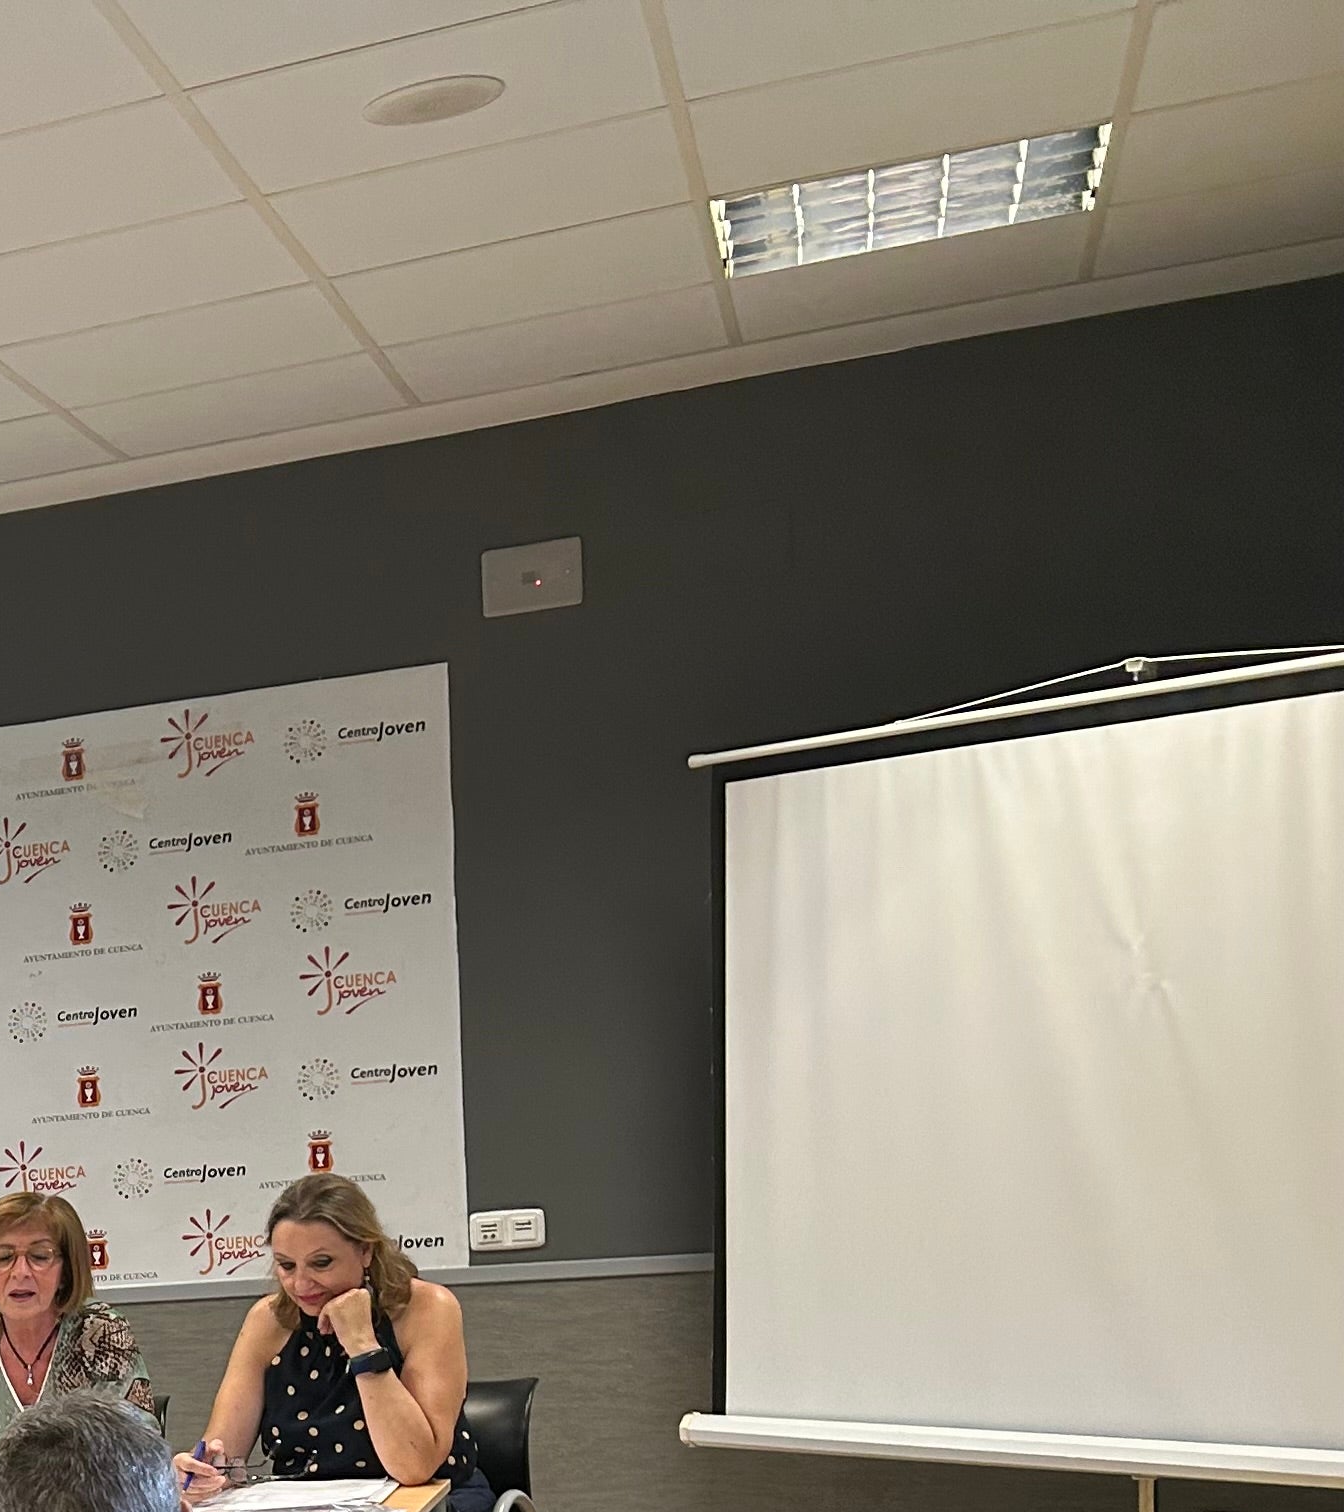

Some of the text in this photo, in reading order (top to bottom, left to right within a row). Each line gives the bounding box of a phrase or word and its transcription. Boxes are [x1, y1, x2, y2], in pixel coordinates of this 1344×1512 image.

[338, 720, 426, 741] CentroJoven
[193, 731, 255, 751] CUENCA
[197, 747, 244, 768] joven
[15, 785, 84, 801] AYUNTAMIENTO
[12, 840, 70, 858] CUENCA
[149, 832, 232, 852] CentroJoven
[244, 839, 318, 856] AYUNTAMIENTO
[336, 833, 374, 847] CUENCA
[16, 856, 61, 874] joven
[200, 900, 261, 918] CUENCA
[344, 892, 432, 913] CentroJoven
[204, 915, 251, 934] joven
[23, 948, 92, 964] AYUNTAMIENTO
[108, 943, 143, 956] CUENCA
[334, 970, 397, 988] CUENCA
[337, 987, 386, 1006] joven
[57, 1006, 137, 1025] CentroJoven
[150, 1018, 221, 1033] AYUNTAMIENTO
[238, 1014, 274, 1026] CUENCA
[208, 1067, 268, 1084] CUENCA
[351, 1064, 438, 1082] CentroJoven
[211, 1081, 258, 1100] joven
[31, 1111, 100, 1124] AYUNTAMIENTO
[116, 1107, 151, 1118] CUENCA
[29, 1166, 85, 1181] CUENCA
[164, 1164, 246, 1182] CentroJoven
[215, 1235, 267, 1250] CUENC
[218, 1247, 265, 1265] joven
[123, 1271, 159, 1280] CUENCA
